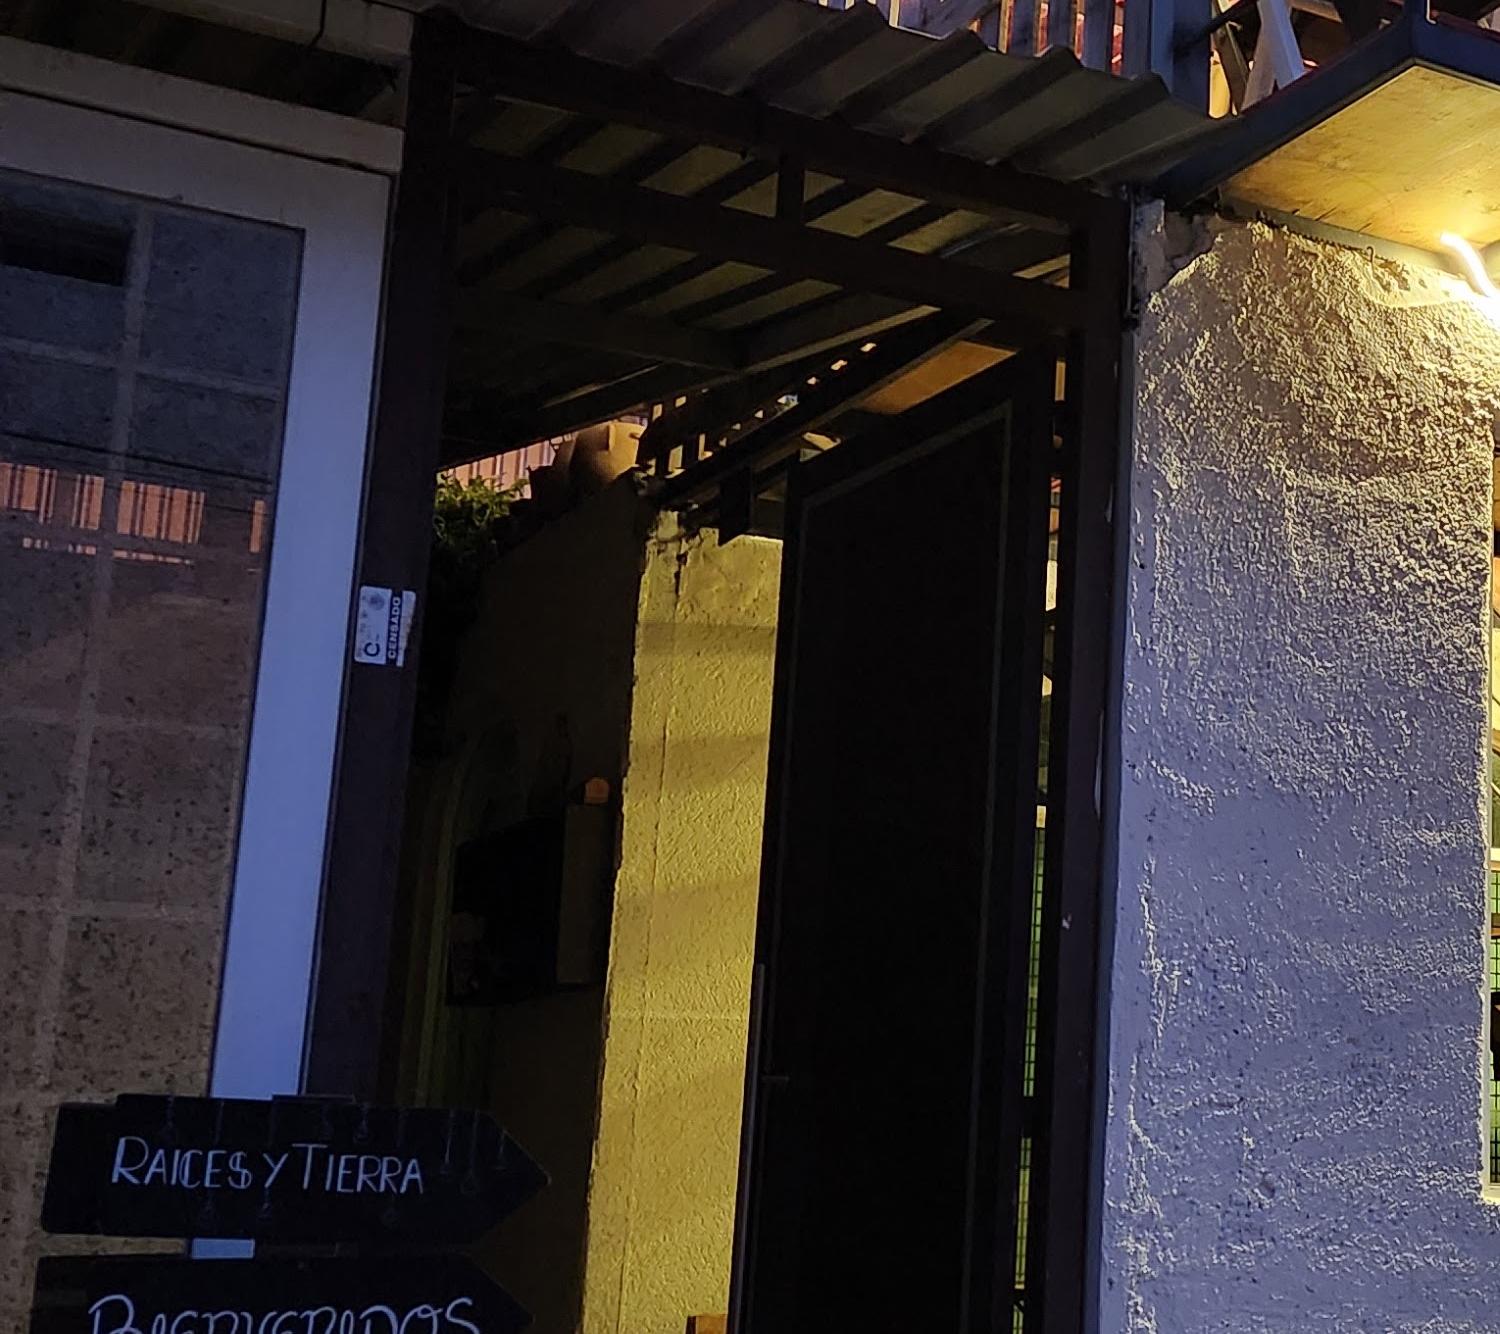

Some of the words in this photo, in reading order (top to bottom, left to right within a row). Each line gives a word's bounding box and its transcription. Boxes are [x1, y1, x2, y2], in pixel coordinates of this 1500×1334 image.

[388, 597, 401, 660] CENSADO
[111, 1135, 253, 1190] RAICES
[292, 1142, 424, 1195] TIERRA
